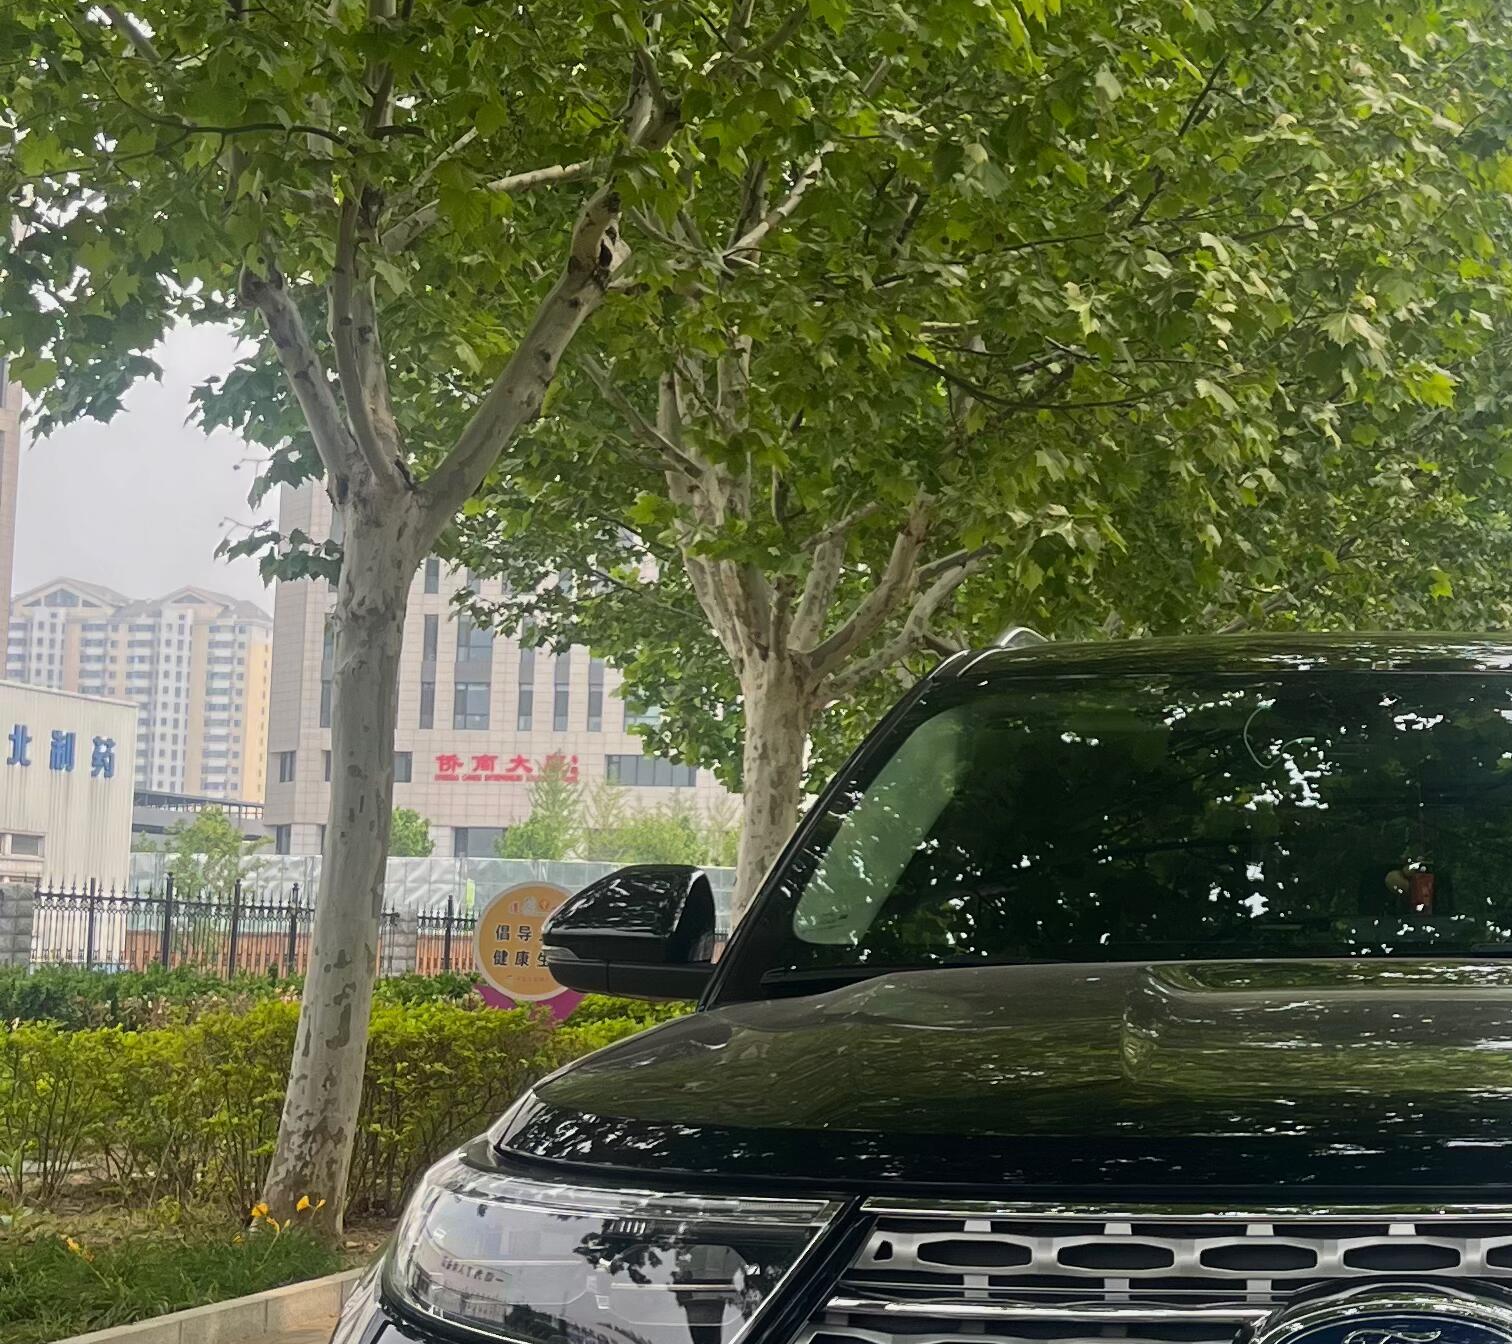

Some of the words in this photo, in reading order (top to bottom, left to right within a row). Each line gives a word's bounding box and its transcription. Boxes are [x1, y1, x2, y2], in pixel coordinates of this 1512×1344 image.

[7, 723, 116, 779] 北制药
[496, 924, 543, 941] 倡导
